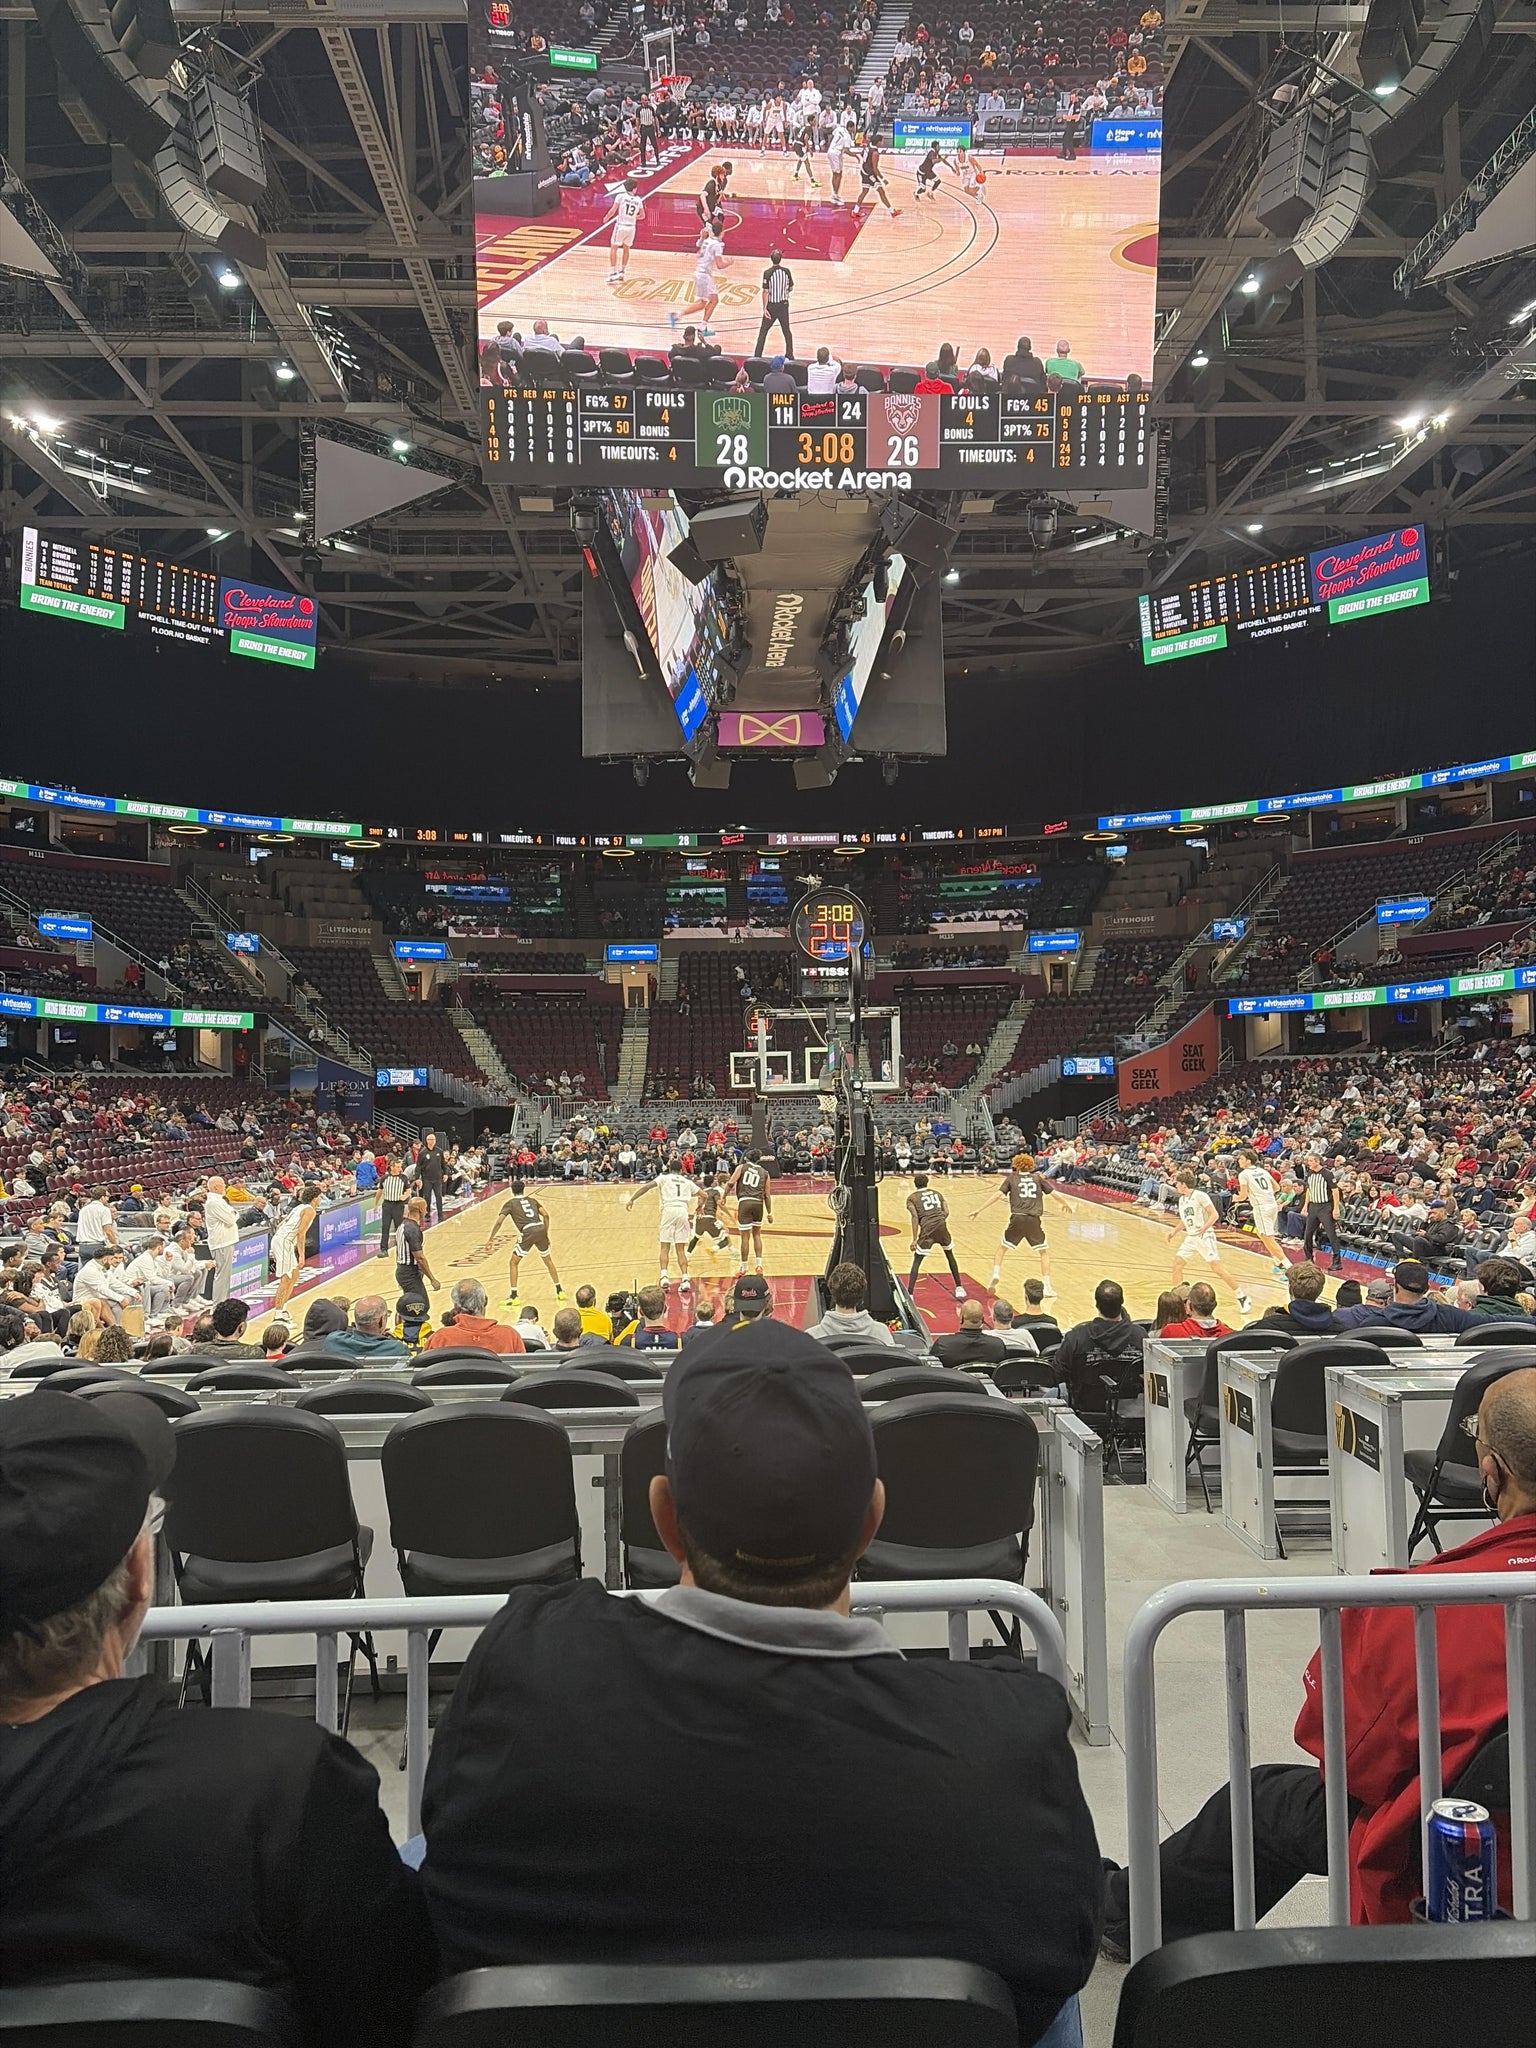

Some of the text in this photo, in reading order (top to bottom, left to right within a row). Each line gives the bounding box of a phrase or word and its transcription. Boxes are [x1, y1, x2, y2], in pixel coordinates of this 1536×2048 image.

[625, 204, 635, 216] 13
[504, 389, 575, 400] PTS REB AST FLS
[646, 393, 685, 407] FOULS
[772, 394, 794, 405] HALF
[1078, 393, 1149, 403] PTS REB AST FLS
[488, 400, 572, 412] 0 3 1 1 0
[586, 396, 627, 408] FG% 57
[884, 396, 922, 409] BONNIES
[951, 395, 989, 410] FOULS
[1007, 399, 1048, 411] FG% 45
[661, 409, 669, 423] 4
[775, 407, 793, 425] 1H
[842, 402, 861, 420] 24
[1061, 406, 1072, 416] 00
[965, 411, 974, 425] 4
[584, 421, 630, 434] 3PT% 50
[640, 426, 670, 437] BONUS
[944, 428, 973, 439] BONUS
[1004, 424, 1049, 436] 3PT% 75
[488, 438, 573, 450] 10 8 2 1 0
[716, 434, 748, 465] 28
[798, 432, 854, 464] 3:08
[887, 435, 919, 466] 26
[1060, 444, 1070, 453] 24
[488, 451, 573, 463] 13 7 1 0 0
[600, 446, 677, 460] TIMEOUTS: 4
[959, 448, 1034, 463] TIMEOUTS: 4
[1059, 456, 1070, 466] 32
[748, 466, 911, 489] Rocket Arena
[25, 540, 33, 572] BONNIES
[1315, 533, 1396, 582] Cleveland
[1319, 576, 1355, 600] Hoops
[1356, 549, 1421, 588] Showdown
[30, 593, 115, 620] BRING THE ENERGY
[224, 588, 296, 614] Cleveland
[1338, 587, 1419, 615] BRING THE ENERGY
[1298, 609, 1308, 617] ON
[1309, 606, 1321, 614] THE
[224, 612, 313, 632] Hoops Showdown
[1139, 601, 1152, 638] BOBCATS
[202, 626, 212, 634] ON
[212, 628, 224, 636] THE
[765, 606, 803, 667] Rocket Arena
[238, 638, 308, 662] BRING THE ENERGY
[1151, 633, 1218, 657] BRING THE ENERGY
[388, 829, 397, 838] 24
[417, 829, 436, 841] 3:08
[472, 833, 482, 842] 1H
[500, 834, 542, 844] TIMEOUTS: 4
[843, 834, 870, 843] FG% 45
[877, 833, 906, 842] FOULS 4
[922, 830, 963, 840] TIMEOUTS: 4
[978, 828, 1002, 838] 5:37 PM
[580, 837, 585, 845] 4
[595, 837, 623, 846] FG% 57
[678, 836, 689, 846] 28
[776, 835, 787, 845] 26
[817, 905, 853, 922] 3:08
[1113, 915, 1155, 923] LITEHOUSE
[810, 923, 850, 954] 24
[182, 1013, 242, 1026] BRING THE ENERGY
[1183, 1044, 1204, 1057] SEAT
[1182, 1058, 1205, 1072] GEEK
[1132, 1068, 1157, 1079] SEAT
[1131, 1079, 1159, 1089] GEEK
[743, 1171, 760, 1188] 00
[1255, 1176, 1269, 1190] 10
[675, 1184, 680, 1197] 1
[1018, 1182, 1037, 1198] 32
[921, 1194, 941, 1211] 24
[522, 1204, 534, 1218] 5
